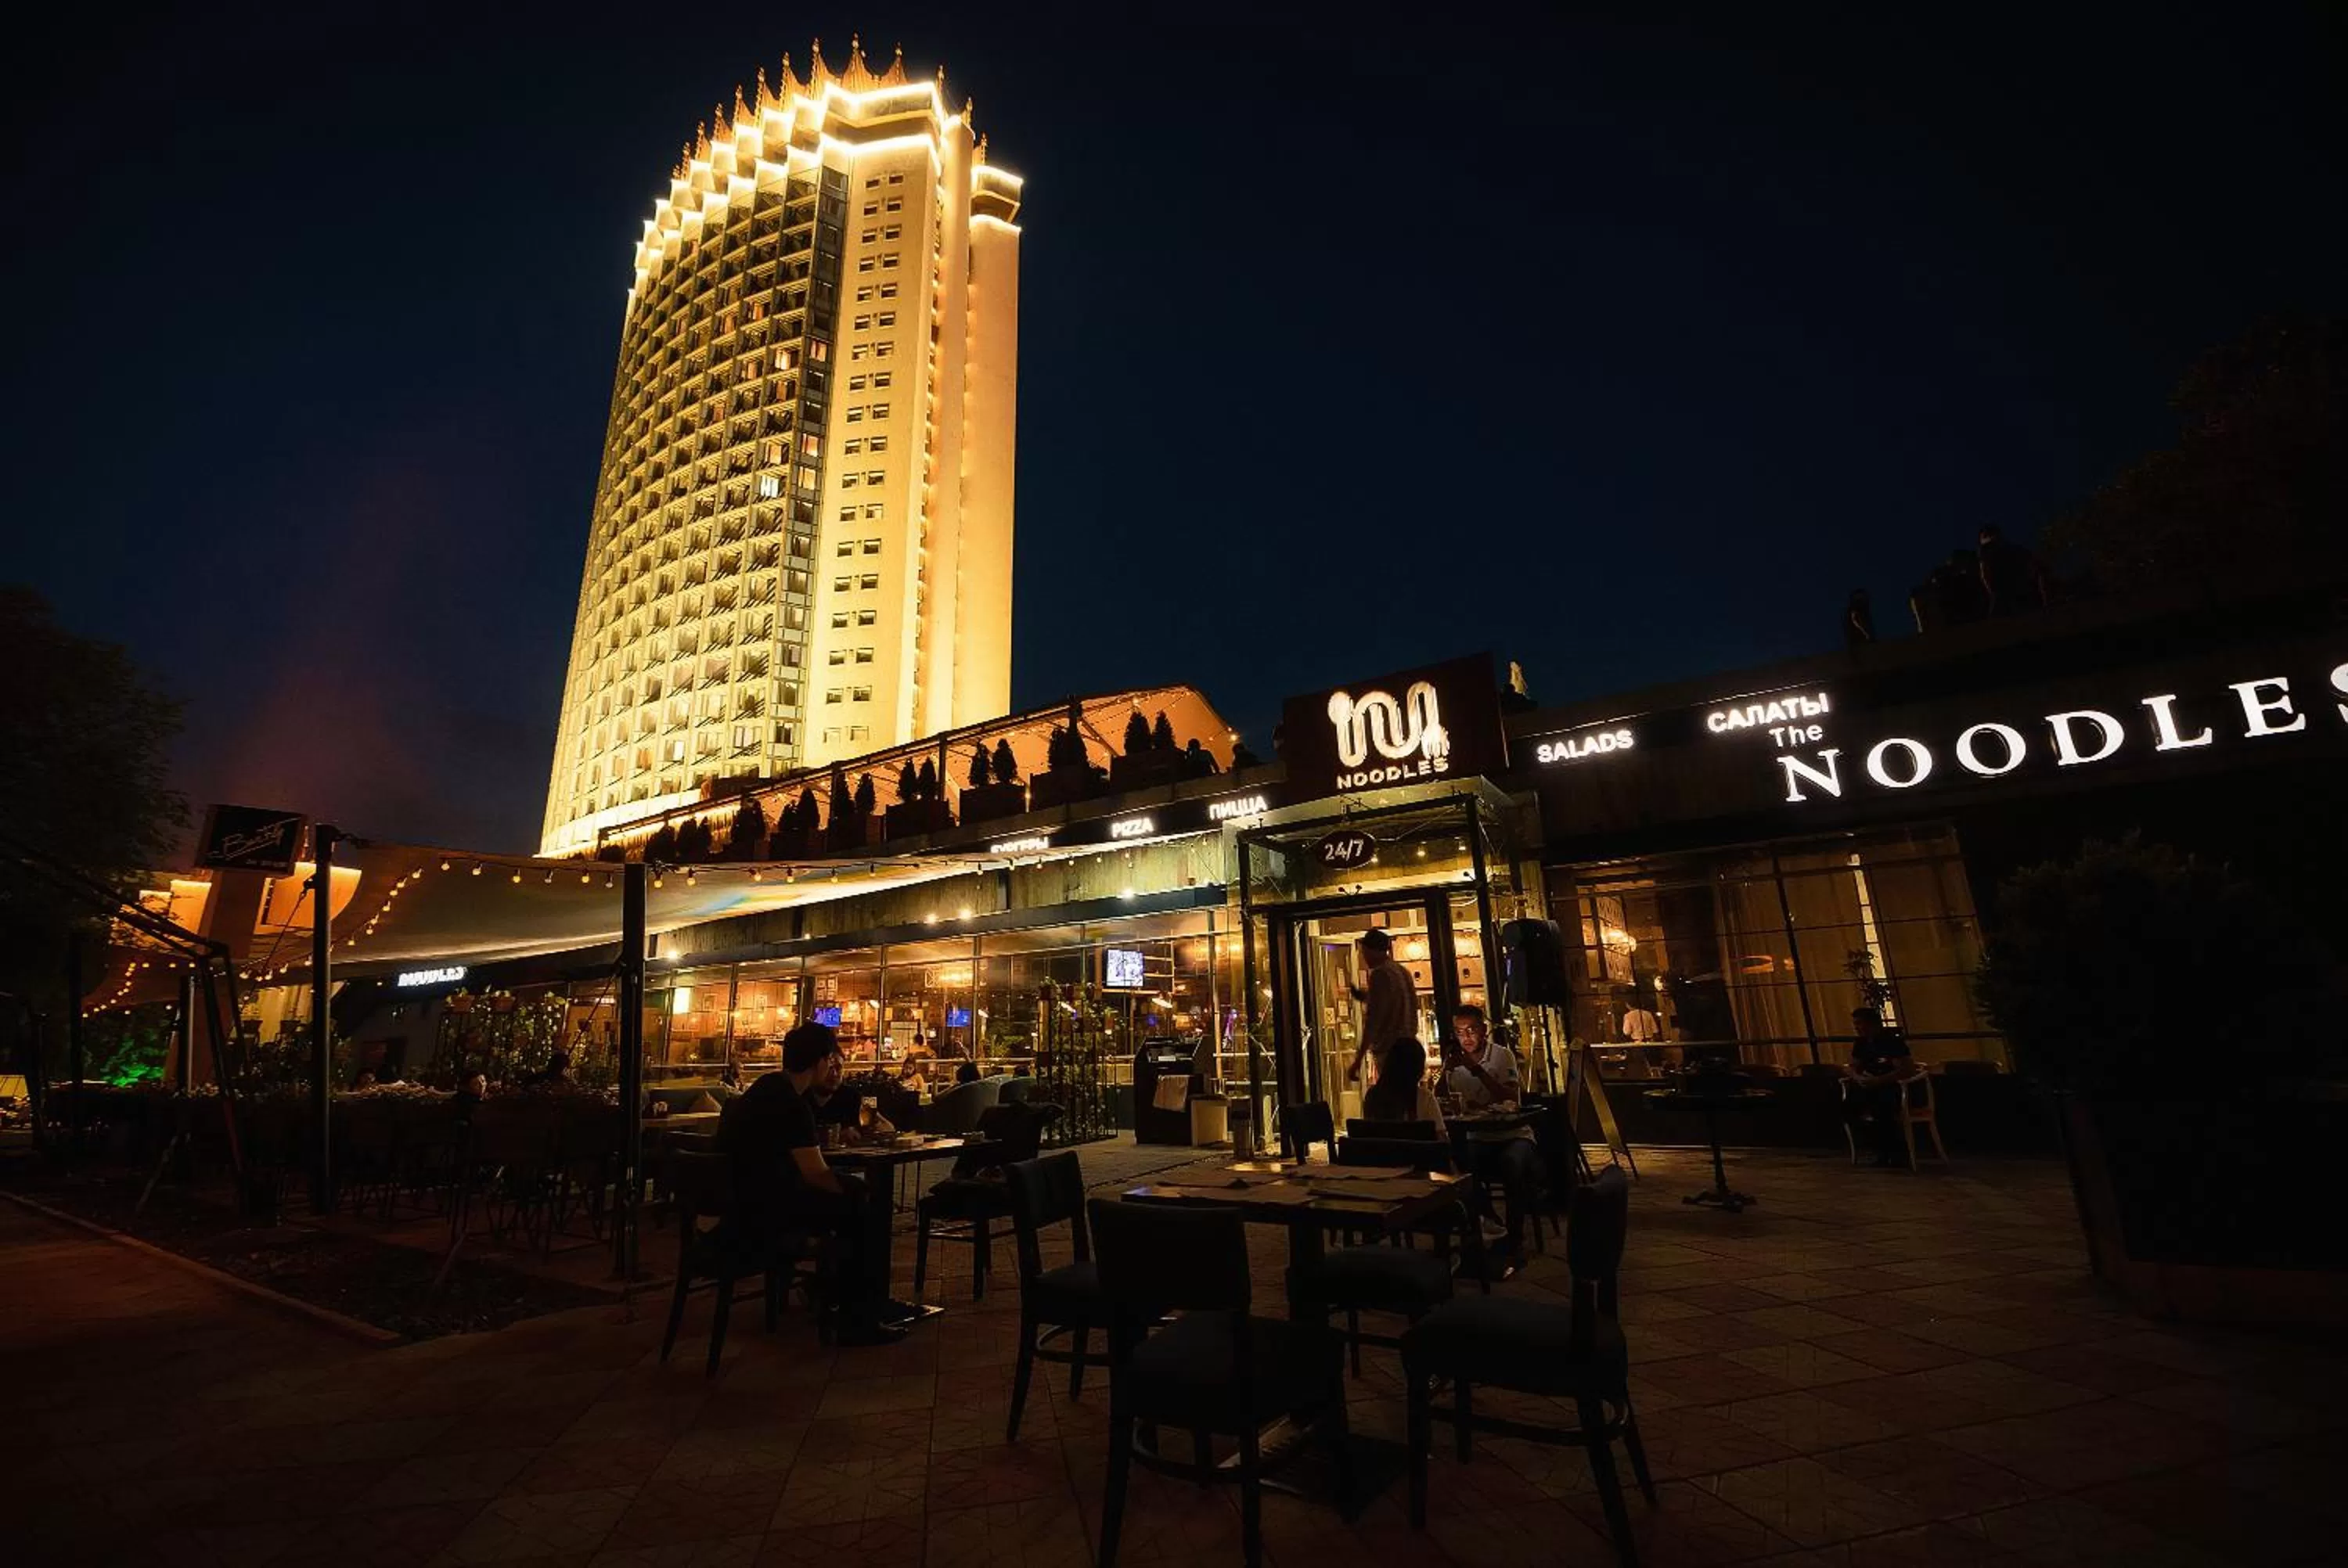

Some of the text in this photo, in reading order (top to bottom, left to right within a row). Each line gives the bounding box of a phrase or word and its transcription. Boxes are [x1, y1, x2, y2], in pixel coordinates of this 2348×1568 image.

[1707, 692, 1829, 732] САЛАТЫ
[1536, 730, 1634, 763] SALADS
[1769, 725, 1823, 747] The
[1336, 757, 1449, 789] NOODLES
[1209, 795, 1268, 820] ПИЦЦА
[1111, 817, 1154, 838] PIZZA
[1324, 838, 1364, 861] 24/7
